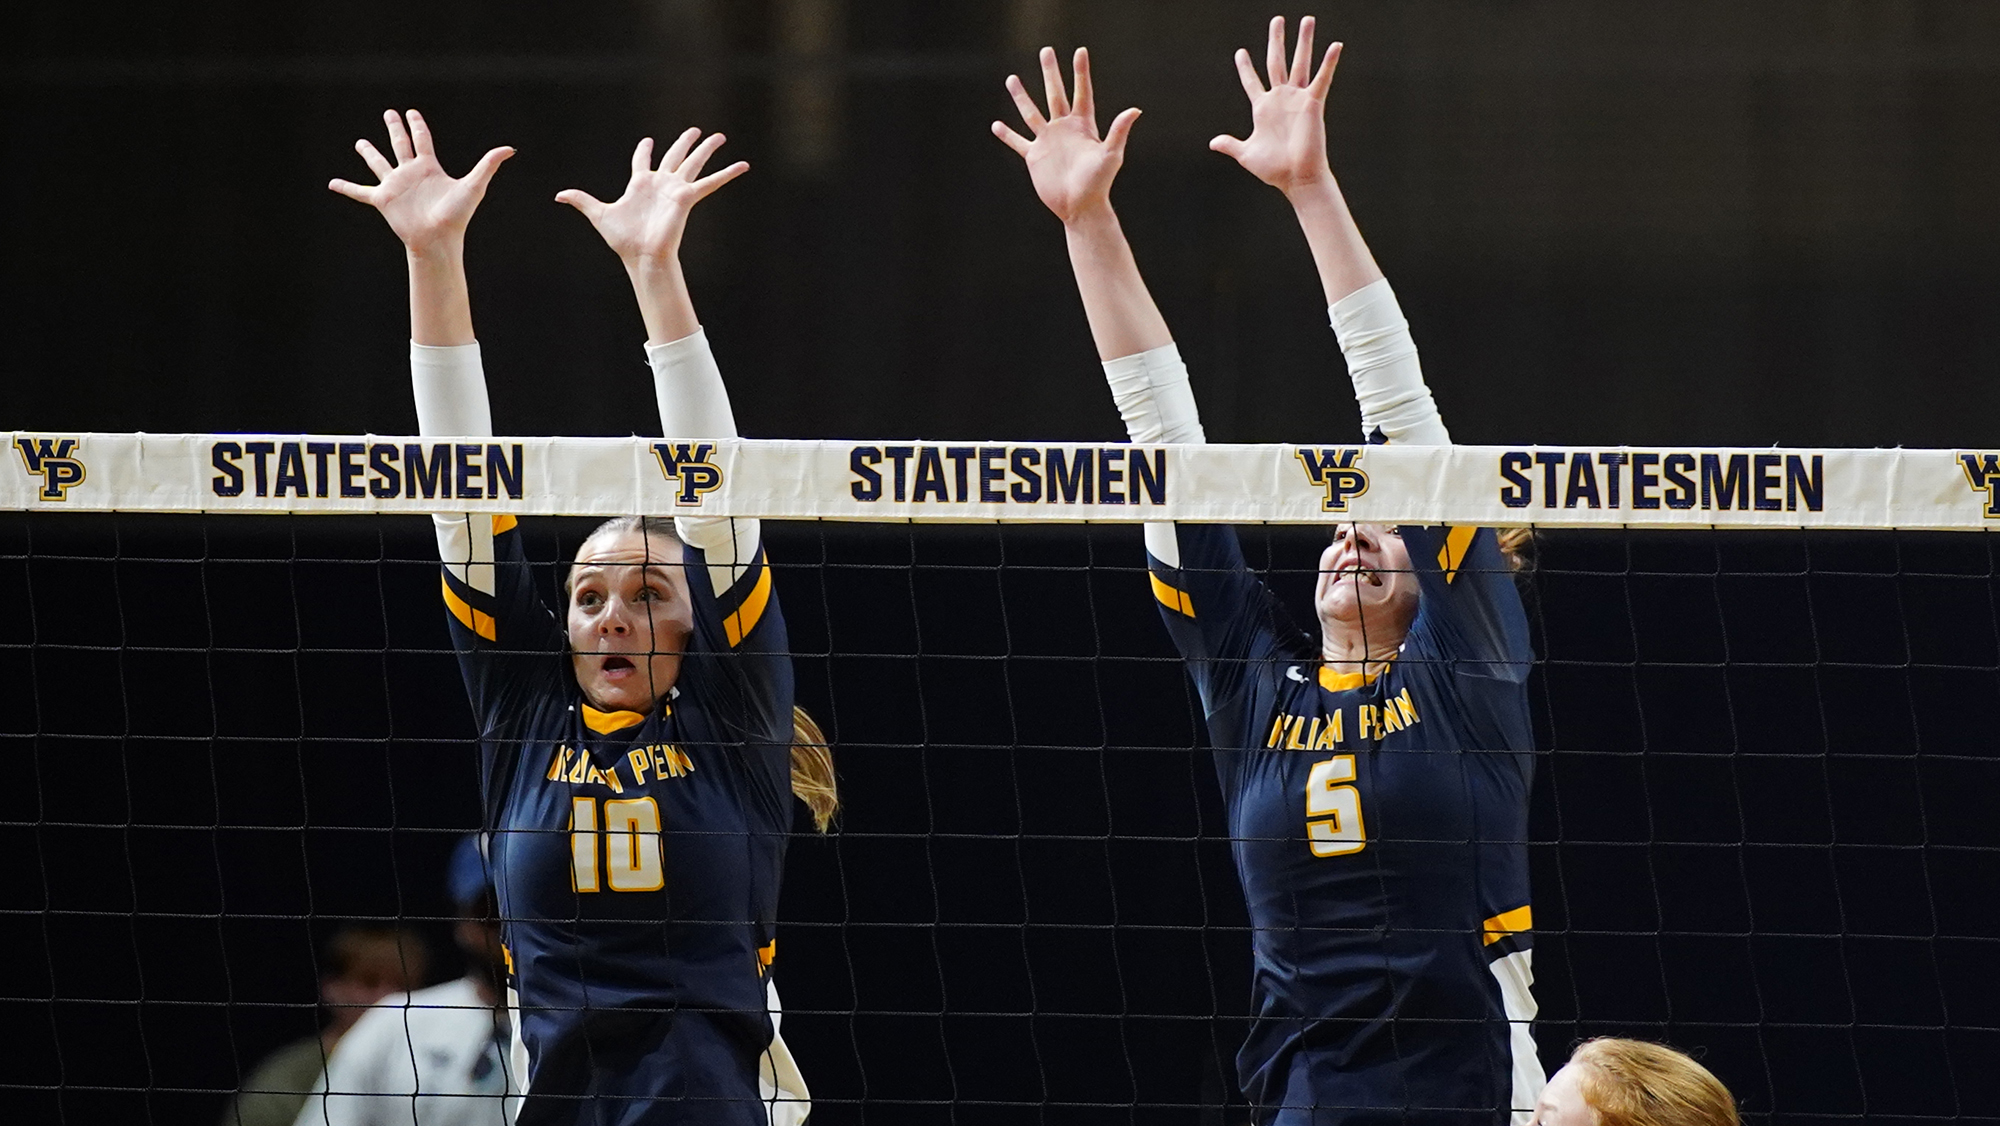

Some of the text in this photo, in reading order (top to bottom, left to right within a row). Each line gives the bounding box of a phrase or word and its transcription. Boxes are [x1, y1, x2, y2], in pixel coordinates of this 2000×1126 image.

[13, 436, 86, 501] WP
[211, 442, 523, 500] STATESMEN
[650, 441, 723, 507] WP
[849, 446, 1167, 504] STATESMEN
[1295, 448, 1369, 512] WP
[1499, 451, 1824, 511] STATESMEN
[568, 796, 665, 893] 10
[1306, 754, 1366, 858] 5
